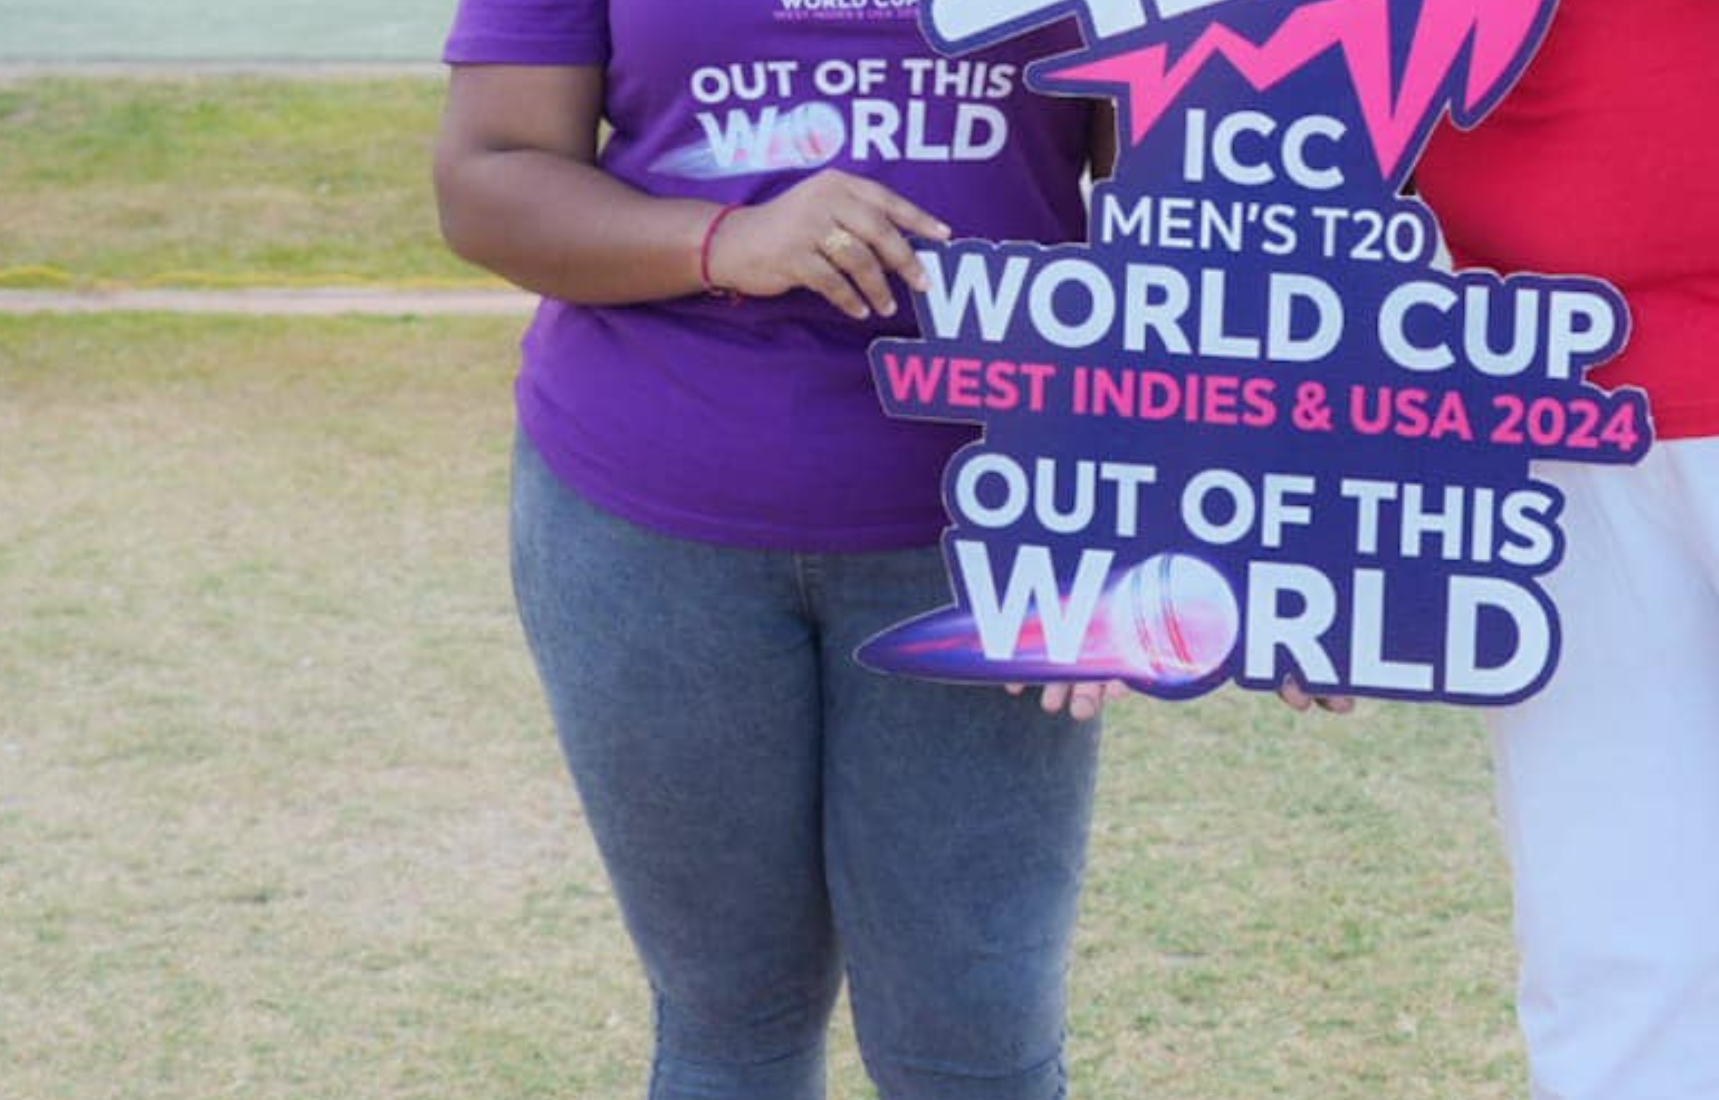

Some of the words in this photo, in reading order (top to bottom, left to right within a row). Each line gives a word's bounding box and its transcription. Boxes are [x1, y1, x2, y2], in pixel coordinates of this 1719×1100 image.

[691, 61, 798, 103] OUT
[814, 59, 887, 97] OF
[902, 58, 1017, 100] THIS
[696, 99, 1009, 169] WORLD
[1183, 108, 1348, 190] ICC
[1102, 194, 1297, 255] MEN'S
[1312, 207, 1426, 263] T20
[918, 250, 1344, 363] WORLD
[1377, 281, 1616, 380] CUP
[883, 353, 1057, 413] WEST
[1072, 366, 1277, 428] INDIES
[1291, 381, 1333, 432] &
[1349, 384, 1474, 442] USA
[1488, 394, 1639, 451] 2024
[955, 453, 1157, 538] OUT
[1181, 468, 1316, 548] OF
[1340, 478, 1555, 566] THIS
[954, 538, 1551, 697] WORLD
